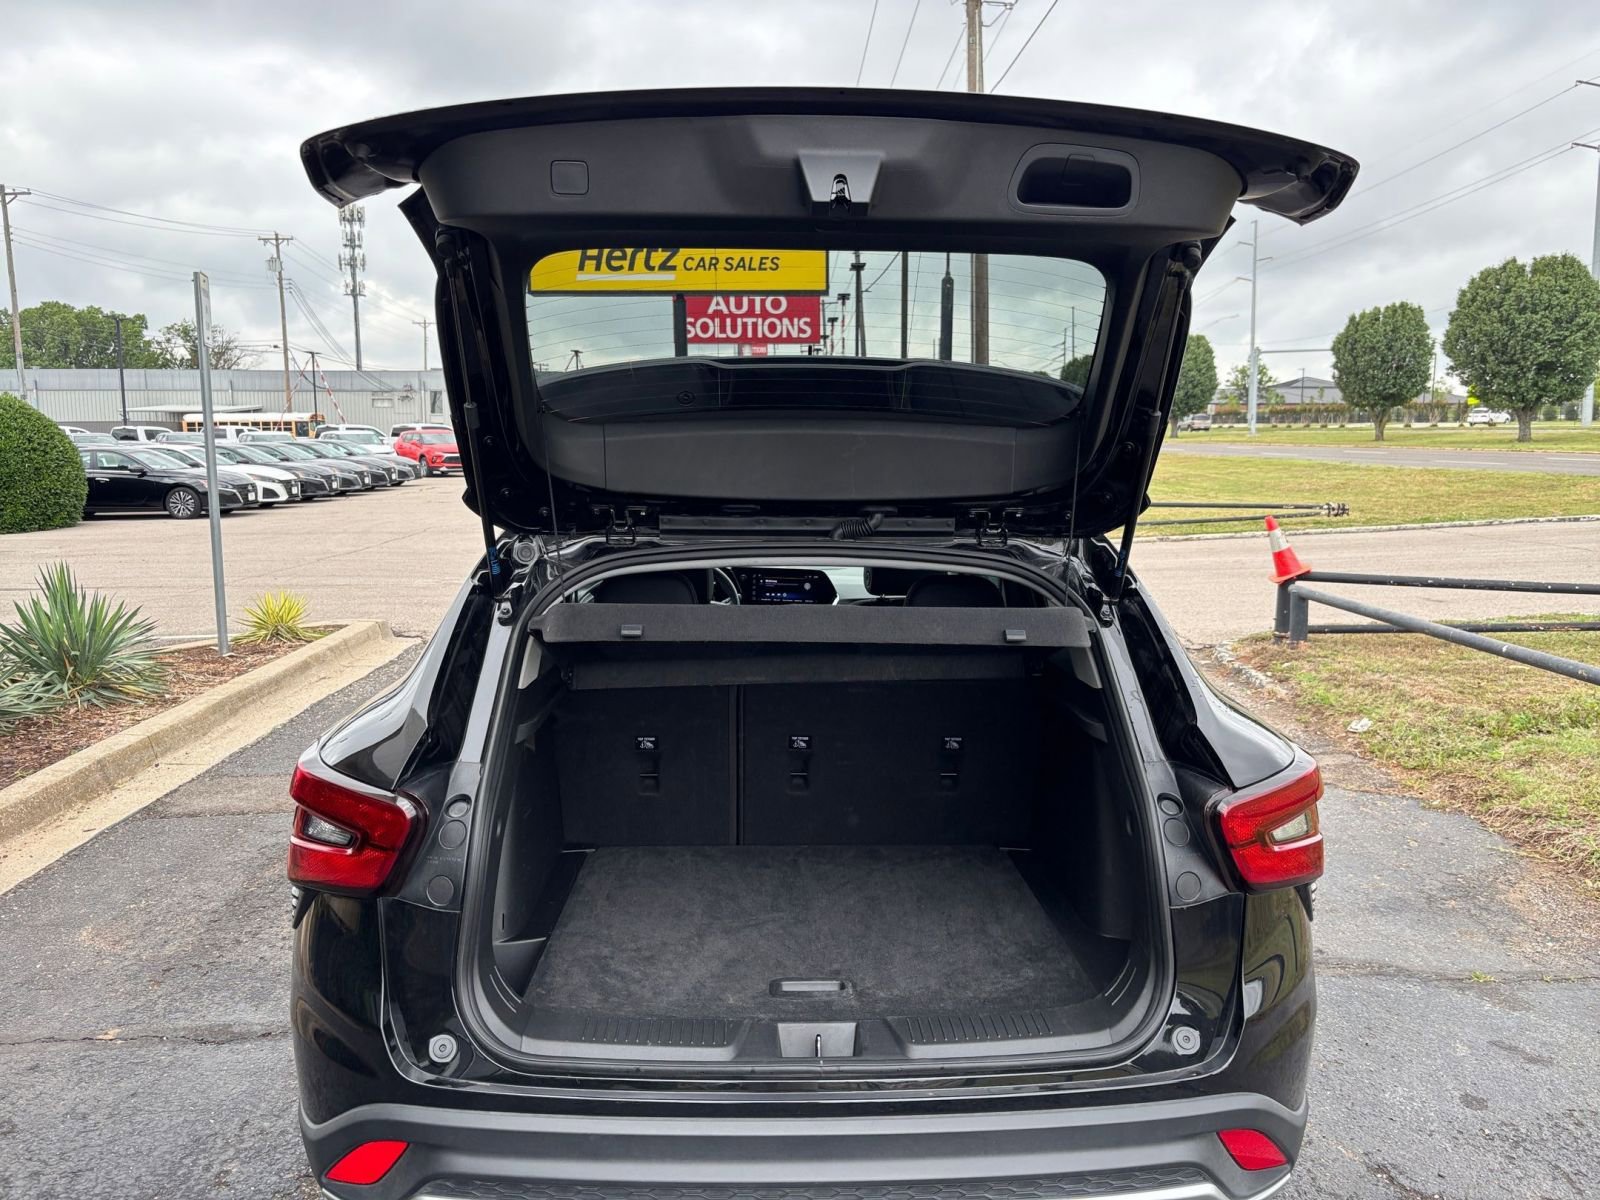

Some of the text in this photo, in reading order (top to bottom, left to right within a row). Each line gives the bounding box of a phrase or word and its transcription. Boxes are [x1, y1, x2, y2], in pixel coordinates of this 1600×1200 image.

[577, 248, 780, 272] Hertz CAR SALES
[707, 296, 787, 314] AUTO
[686, 317, 812, 339] SOLUTIONS
